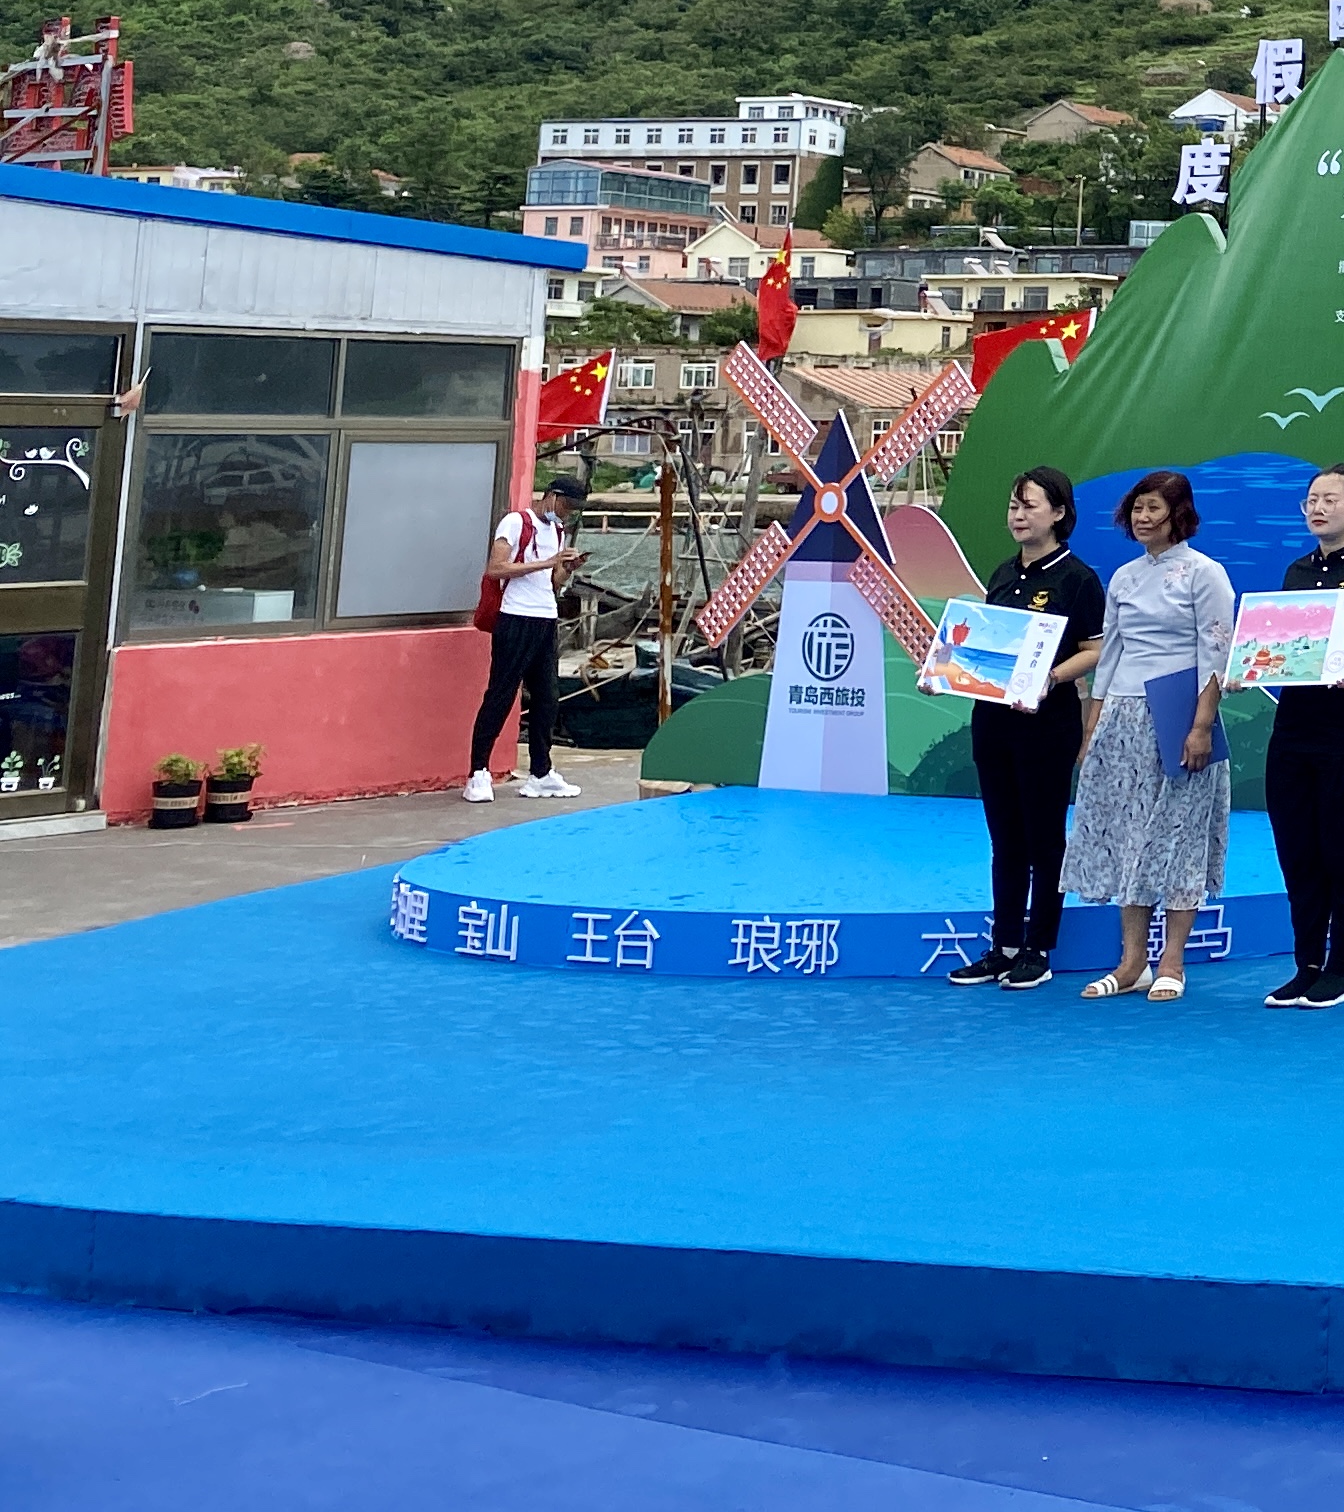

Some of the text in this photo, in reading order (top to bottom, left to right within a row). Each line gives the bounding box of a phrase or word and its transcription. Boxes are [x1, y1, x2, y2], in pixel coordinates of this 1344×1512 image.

[788, 685, 866, 708] 青岛西旅投
[454, 900, 520, 962] 宝山
[566, 910, 661, 970] 王台
[727, 914, 842, 975] 琅琊
